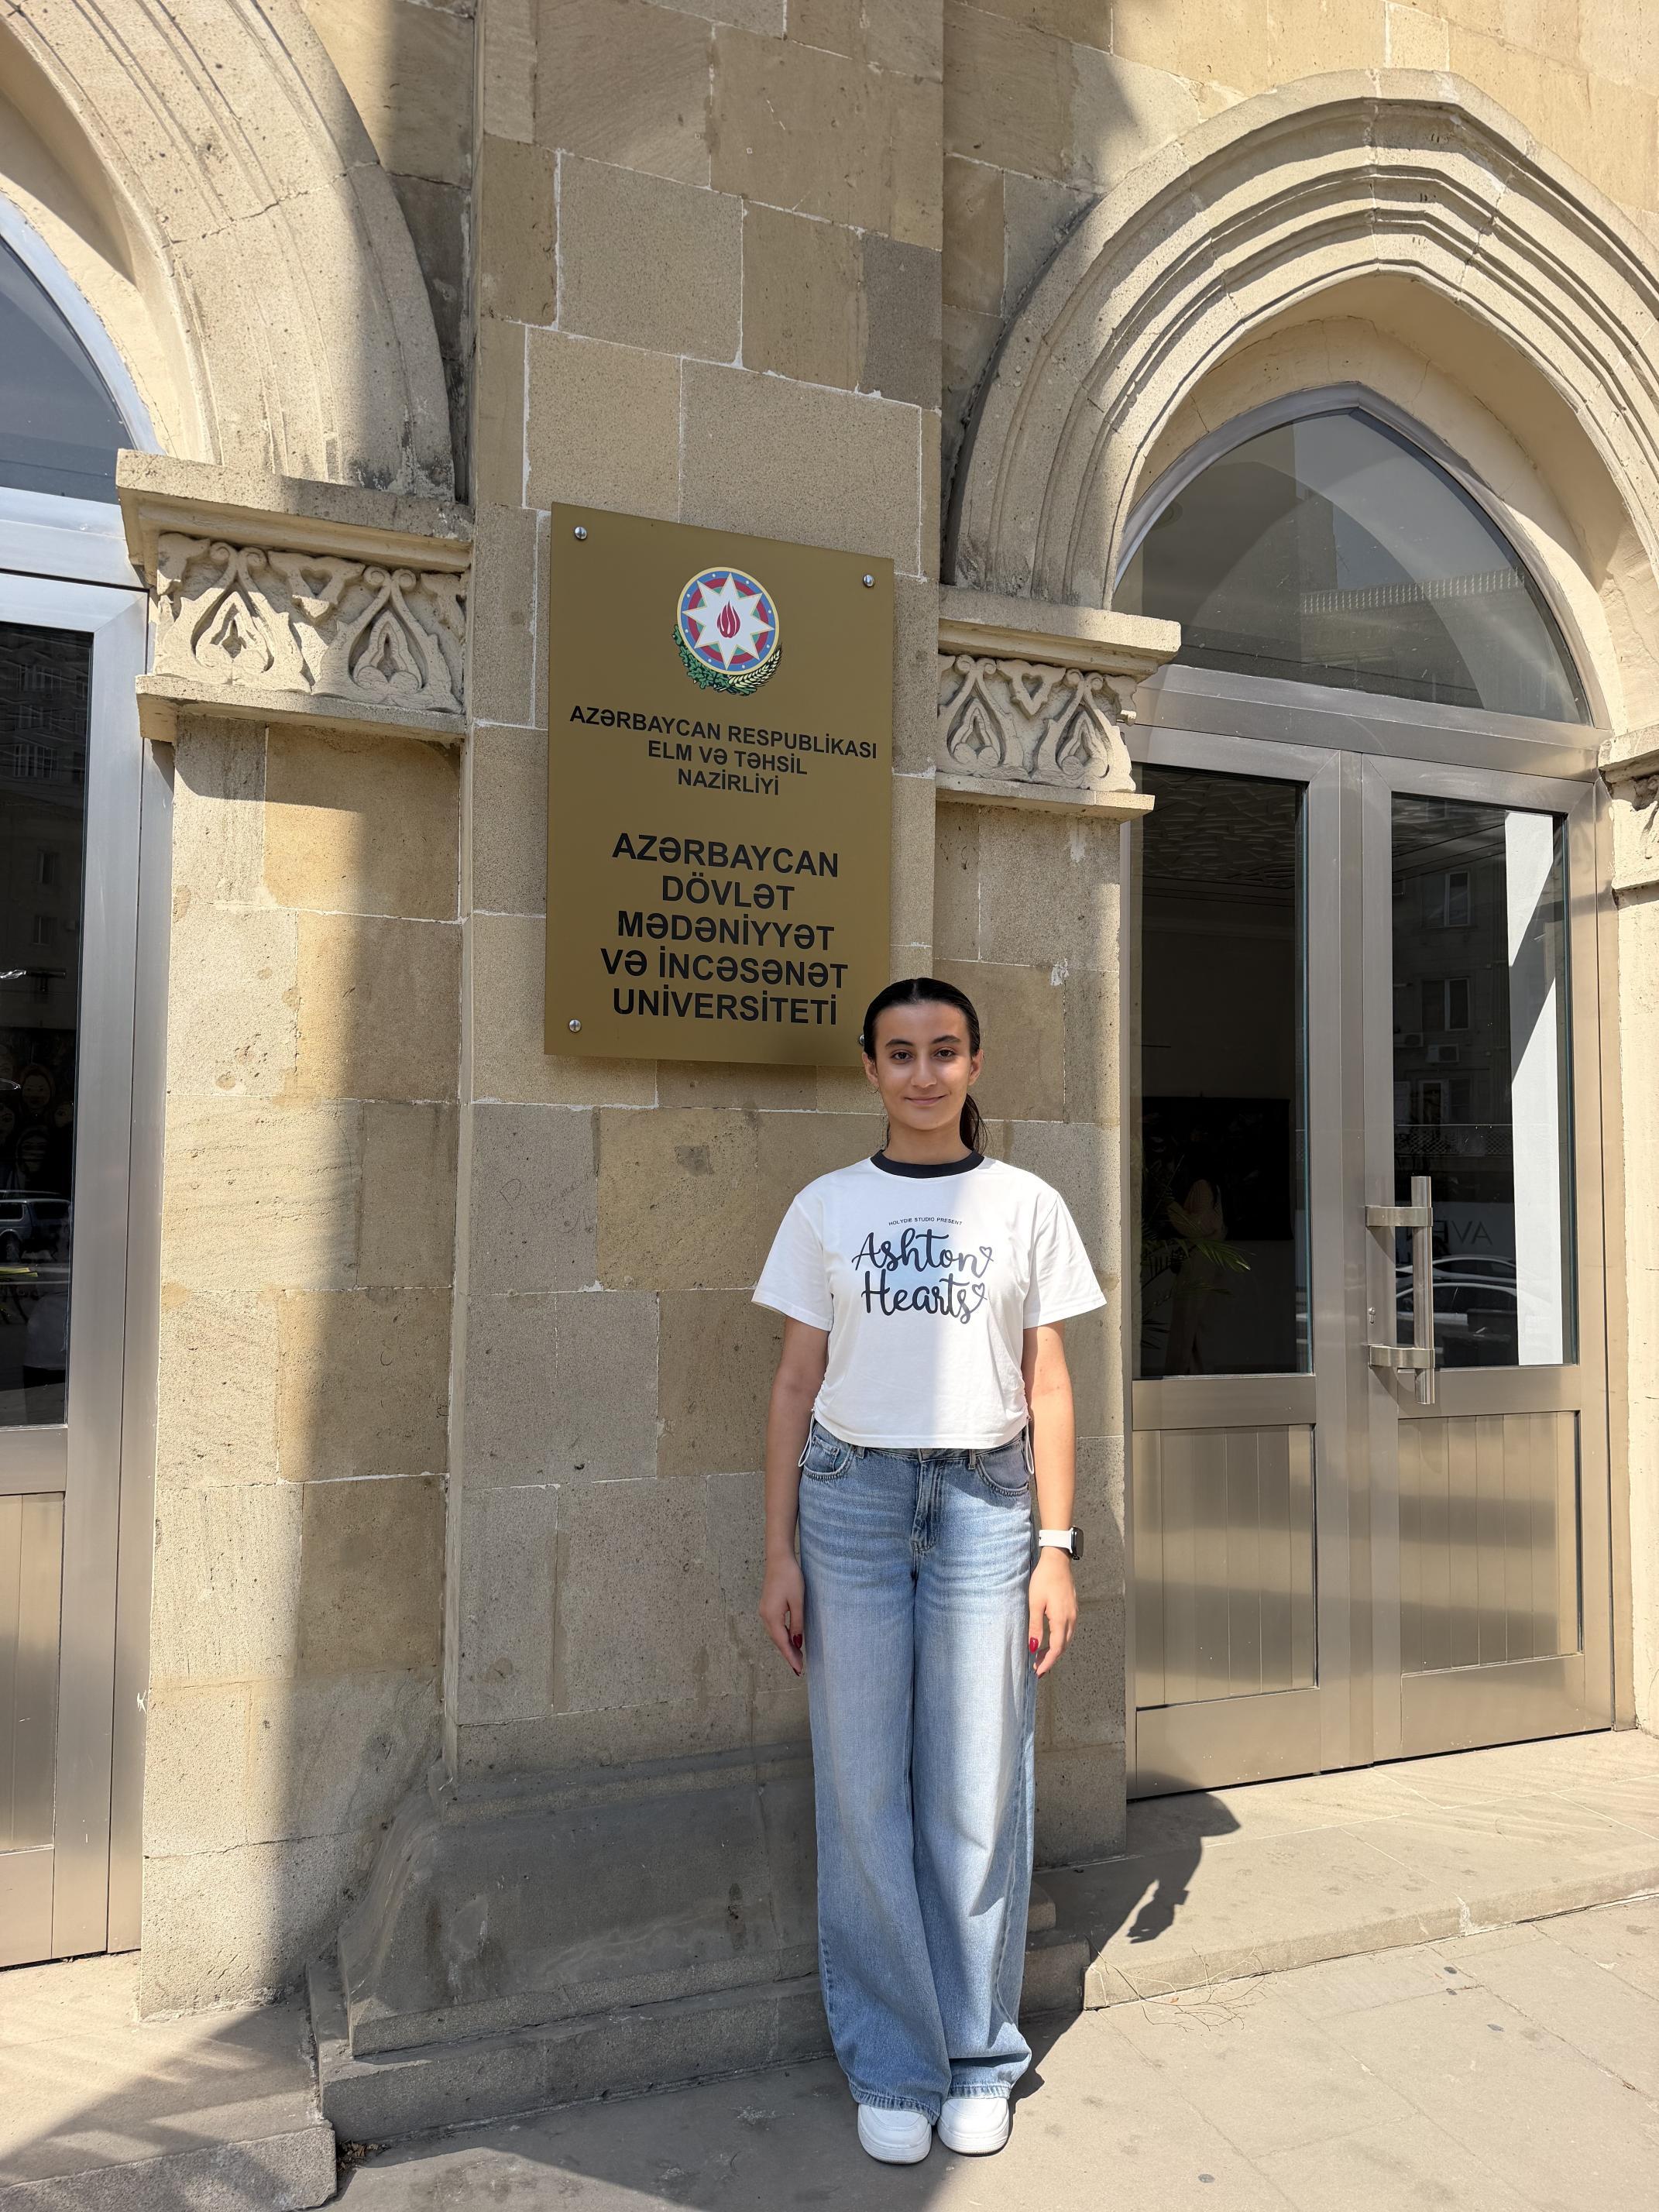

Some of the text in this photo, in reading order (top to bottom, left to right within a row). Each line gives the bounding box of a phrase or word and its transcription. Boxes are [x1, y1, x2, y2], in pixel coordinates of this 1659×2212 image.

[569, 705, 877, 759] AZƏRBAYCAN RESPUBLİKASI
[648, 740, 808, 775] ELM VƏ TƏHSİL
[678, 768, 779, 796] NAZİRLİYİ
[611, 832, 838, 878] AZƏRBAYCAN
[662, 871, 795, 911] DÖVLƏT
[617, 910, 835, 951] MƏDƏNİYYƏT
[599, 945, 849, 989] VƏ İNCƏSƏNƏT
[613, 984, 836, 1025] UNİVERSİTETİ
[851, 1228, 994, 1278] Ashton
[861, 1269, 988, 1324] Hearts
